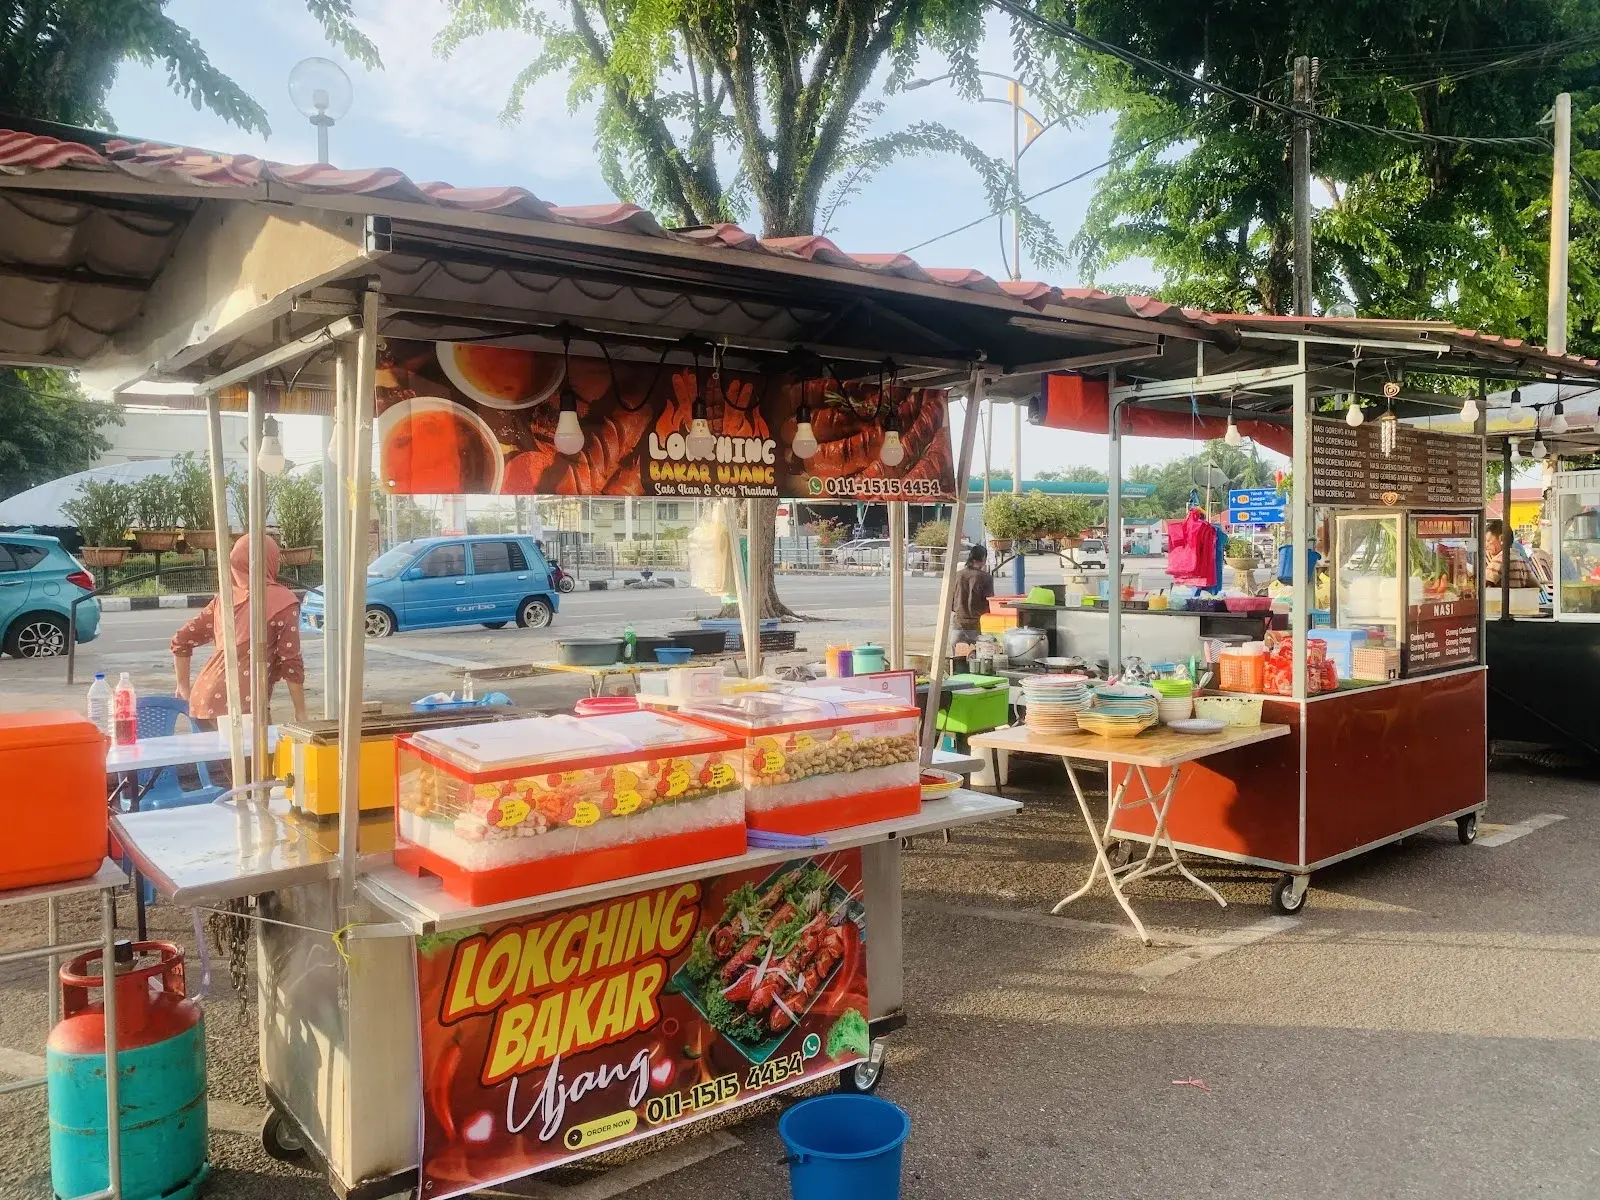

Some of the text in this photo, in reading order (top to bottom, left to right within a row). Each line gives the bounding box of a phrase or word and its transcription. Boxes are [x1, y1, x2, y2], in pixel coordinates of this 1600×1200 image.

[1314, 425, 1324, 433] NASI
[1325, 427, 1343, 435] GORENG
[649, 432, 776, 465] LOHING
[1325, 437, 1344, 446] GORENG
[1314, 446, 1324, 454] NASI
[1325, 448, 1344, 456] GORENG
[1325, 458, 1344, 466] GORENG
[1345, 460, 1361, 468] DAGING
[650, 460, 775, 484] BAKAR UJANG
[1326, 469, 1344, 477] GORENG
[655, 482, 675, 496] Sate
[704, 484, 712, 496] &
[714, 485, 737, 497] Sosej
[738, 485, 778, 497] Thailand
[826, 477, 941, 498] 011-1515 4454
[1314, 478, 1325, 486] NASI
[1326, 479, 1344, 487] GORENG
[455, 603, 496, 612] turbo
[1434, 603, 1454, 617] NASI
[1446, 648, 1458, 656] Goreng
[448, 882, 698, 1016] LOKCHING
[486, 962, 662, 1079] BAKAR
[506, 1048, 650, 1142] Ujang
[646, 1052, 803, 1124] 011-1515 4454
[586, 1118, 631, 1137] ORDER NOW
